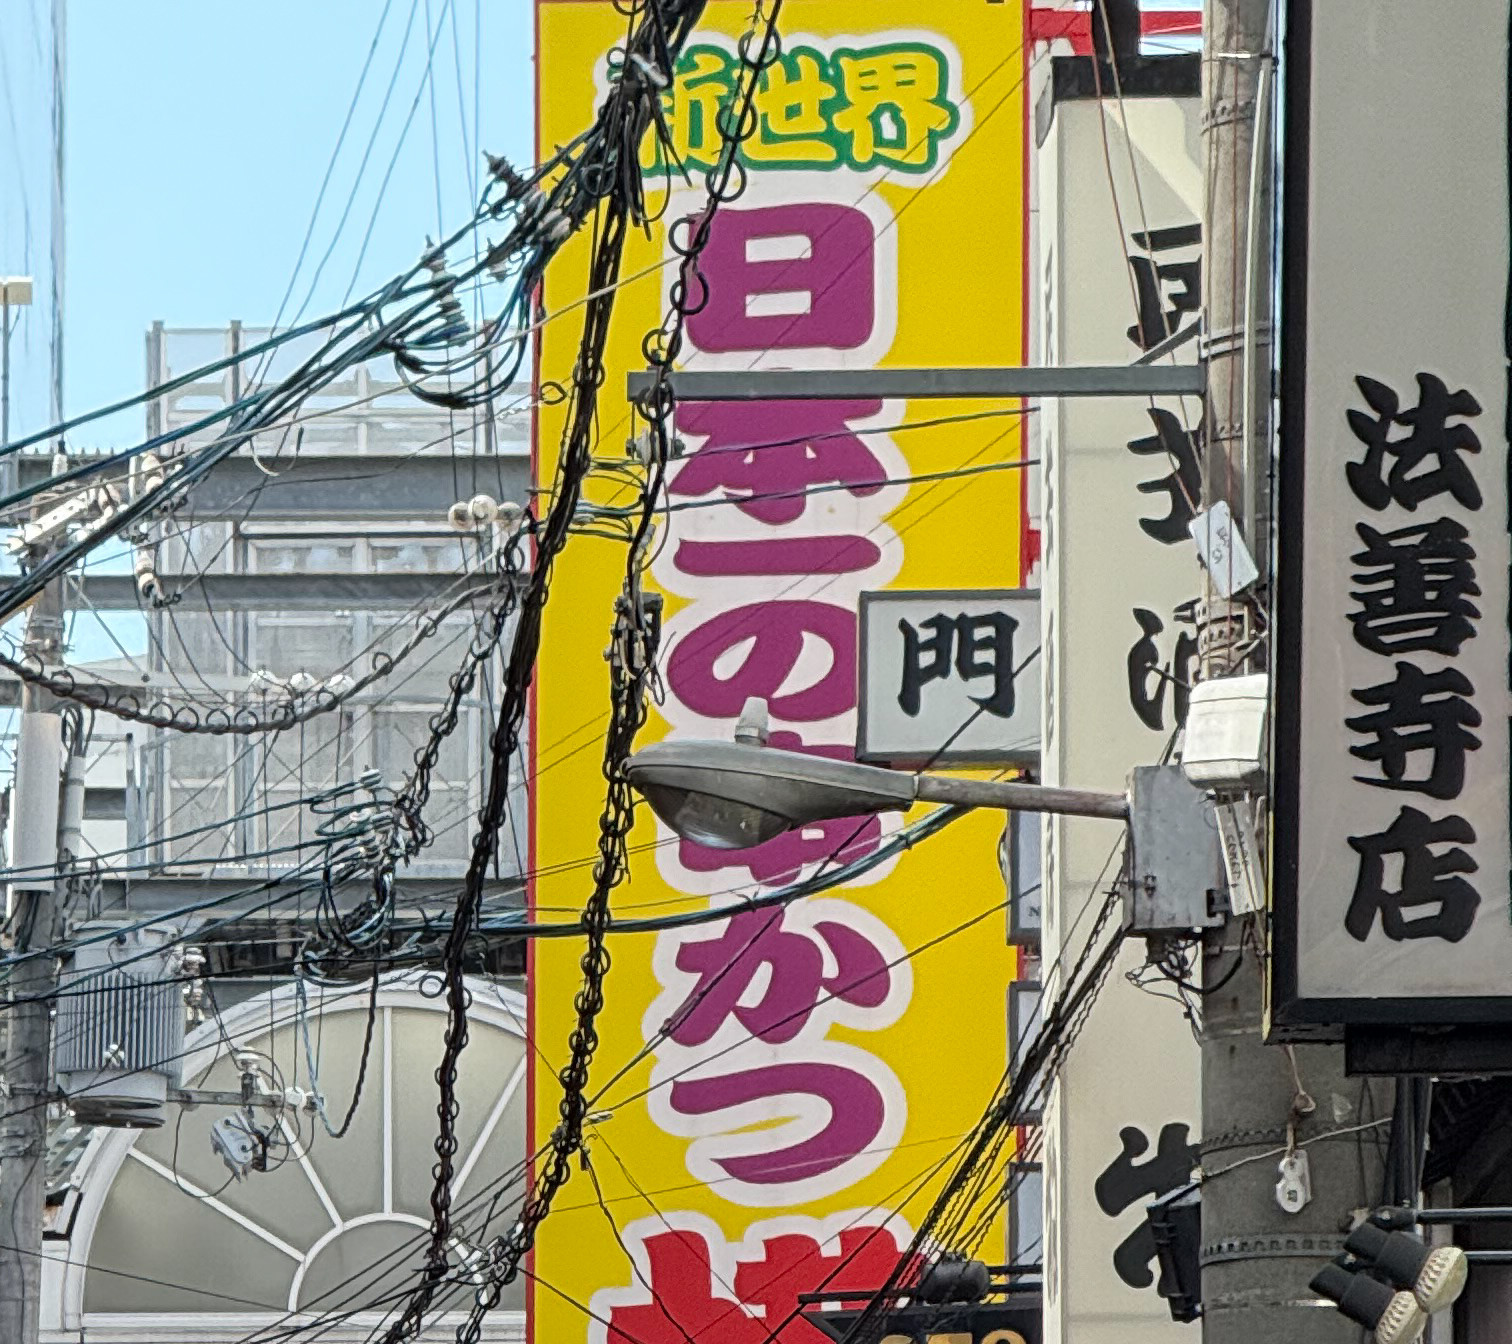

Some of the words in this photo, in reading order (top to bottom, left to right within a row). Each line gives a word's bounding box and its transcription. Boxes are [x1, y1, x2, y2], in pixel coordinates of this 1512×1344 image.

[897, 611, 1020, 718] 門
[1343, 372, 1484, 945] 法善寺店
